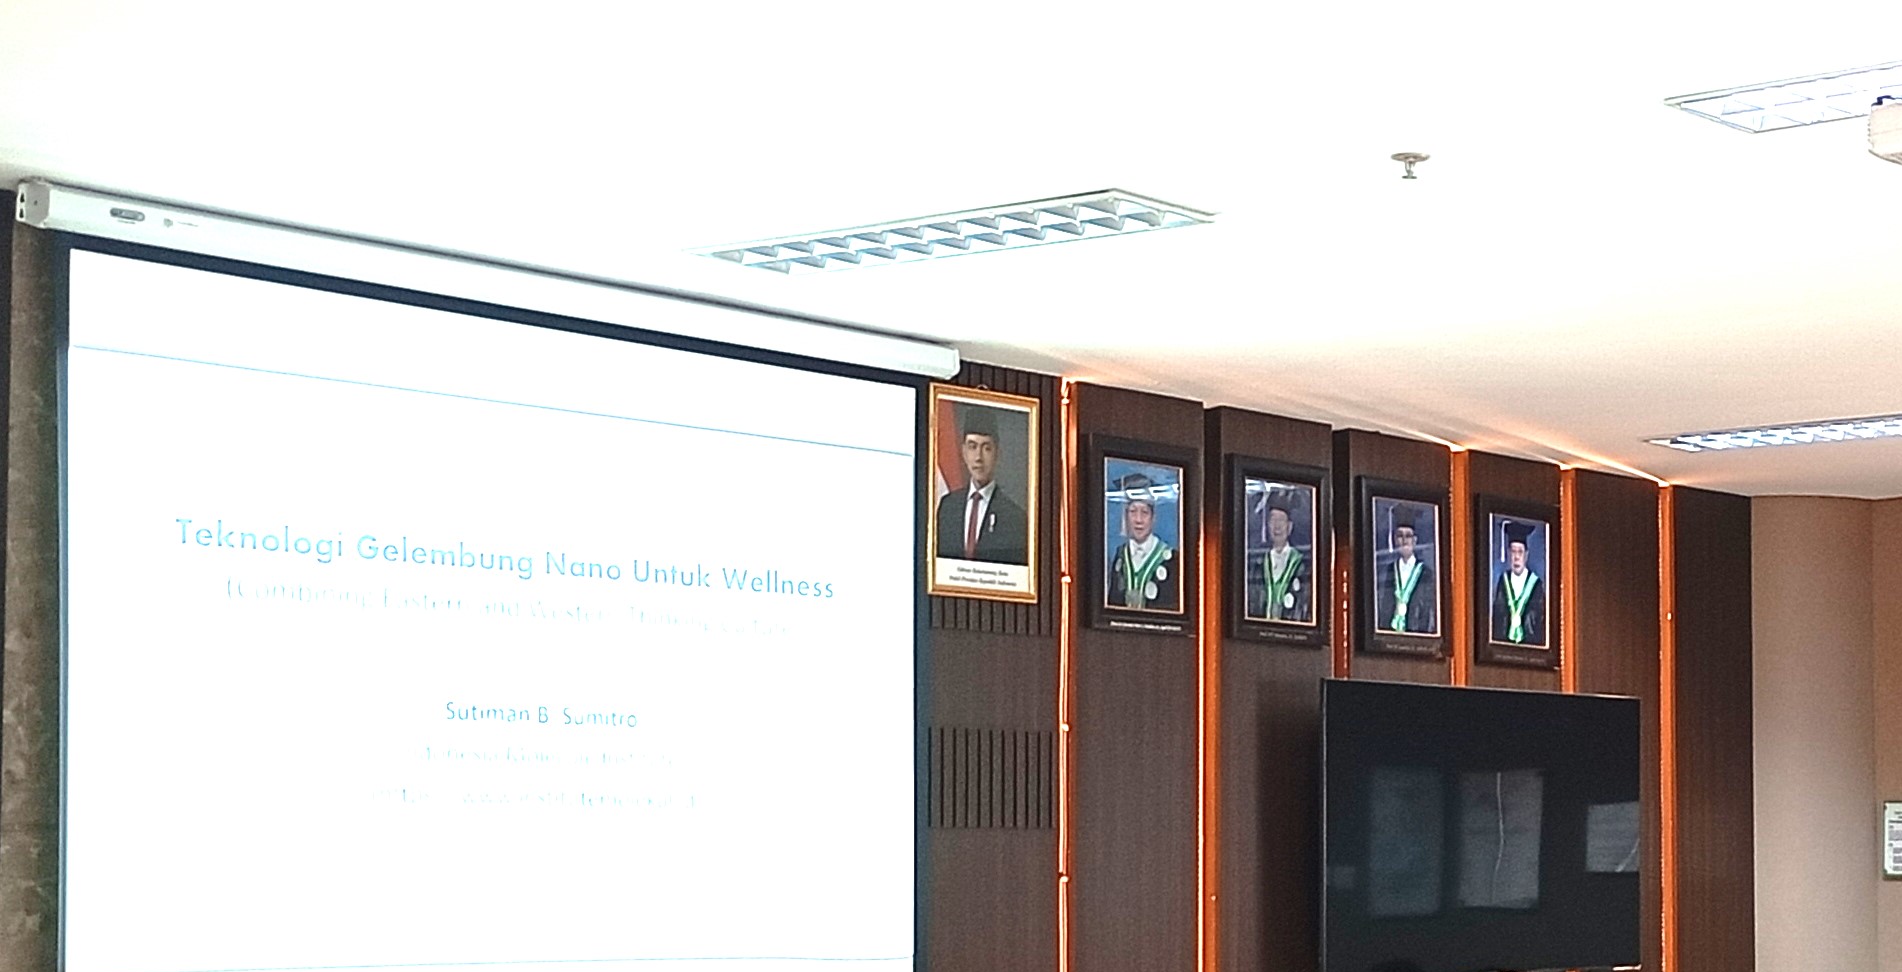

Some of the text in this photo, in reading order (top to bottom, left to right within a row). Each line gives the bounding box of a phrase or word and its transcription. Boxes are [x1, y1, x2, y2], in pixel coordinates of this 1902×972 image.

[175, 517, 834, 599] Teknologi Gelembung Nano Untuk Wellness
[446, 701, 531, 723] Sutiman
[563, 706, 638, 728] Sumitro
